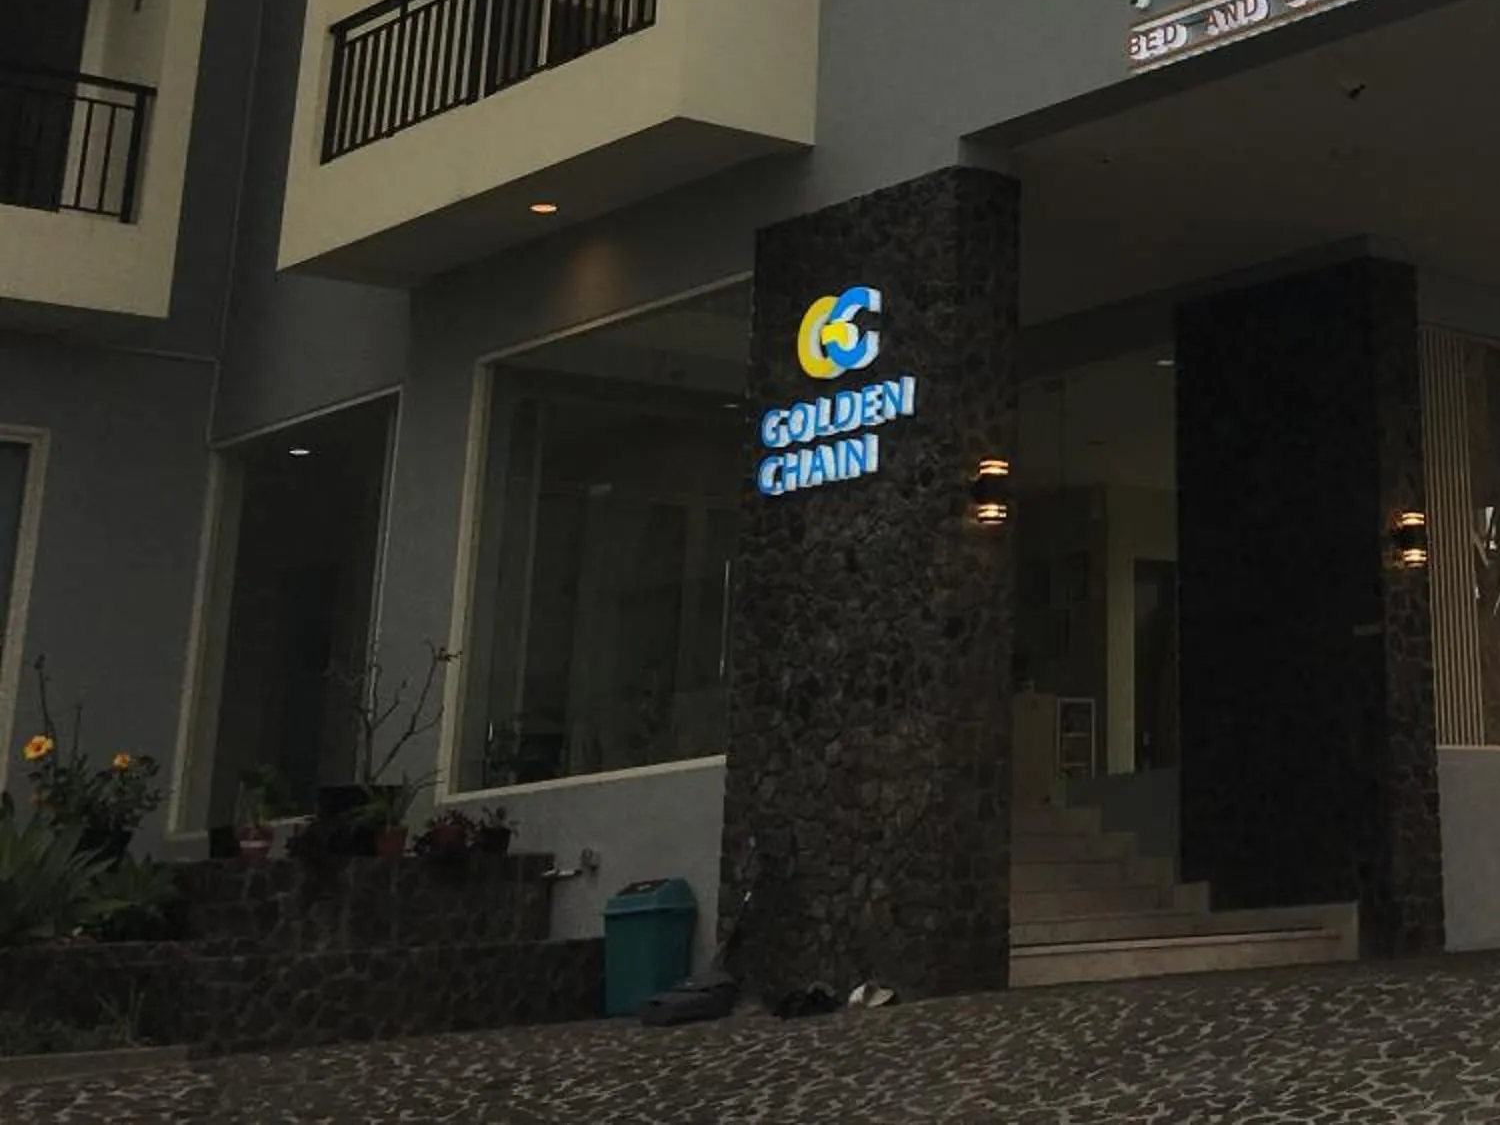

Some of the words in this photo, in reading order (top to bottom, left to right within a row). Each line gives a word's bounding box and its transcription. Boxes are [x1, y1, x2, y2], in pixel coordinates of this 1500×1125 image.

[1128, 21, 1188, 60] BED
[761, 376, 916, 448] GOLDEN
[758, 433, 878, 495] CHAIN
